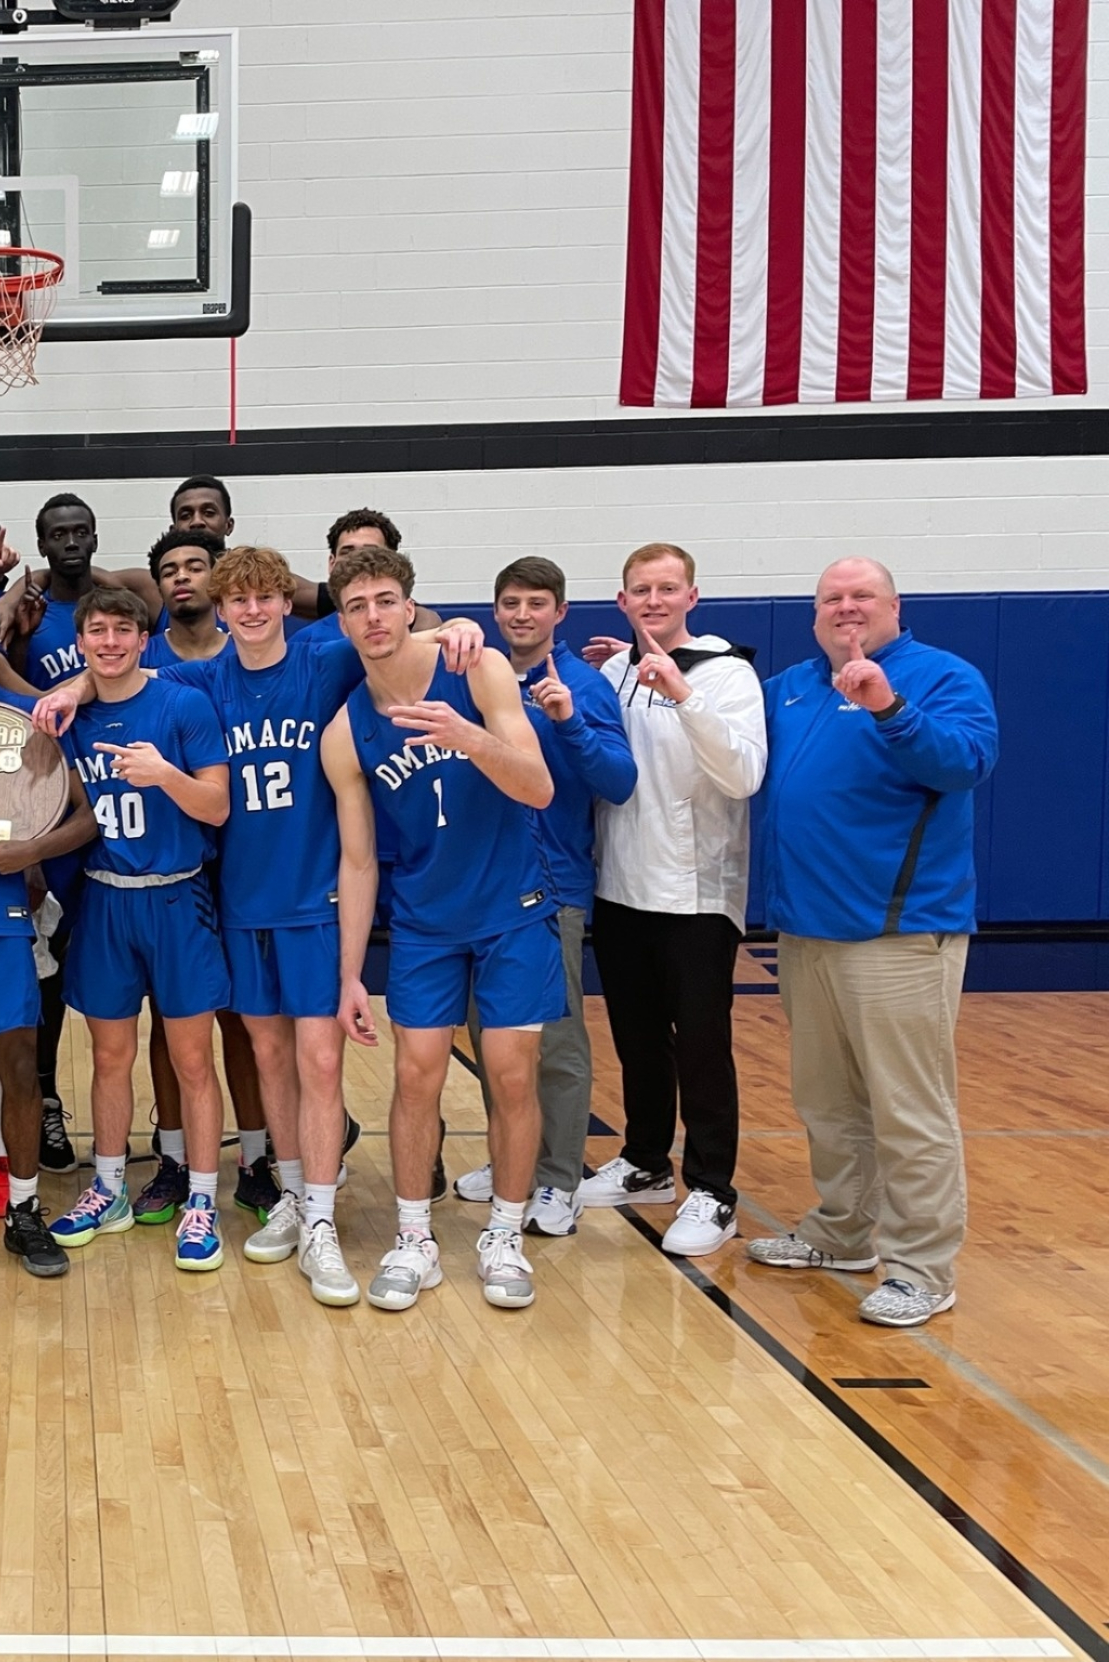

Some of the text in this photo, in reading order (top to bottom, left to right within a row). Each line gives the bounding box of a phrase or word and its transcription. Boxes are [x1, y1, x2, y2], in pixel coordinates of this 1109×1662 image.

[242, 761, 293, 811] 12
[432, 778, 447, 828] 1
[93, 792, 146, 839] 40
